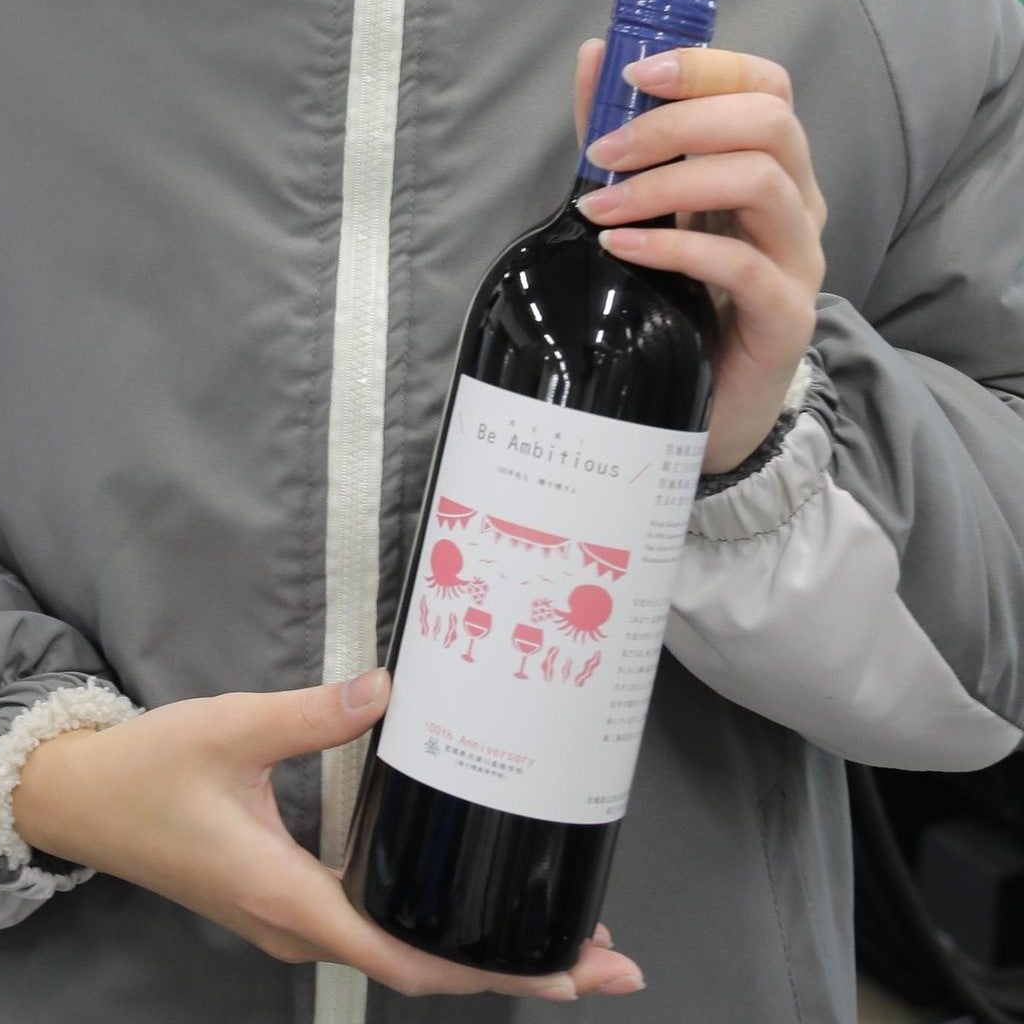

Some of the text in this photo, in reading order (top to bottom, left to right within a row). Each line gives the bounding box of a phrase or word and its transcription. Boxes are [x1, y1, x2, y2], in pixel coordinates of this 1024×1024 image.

[477, 422, 496, 444] Be
[507, 434, 620, 478] Ambitious
[459, 735, 536, 768] Anniversary
